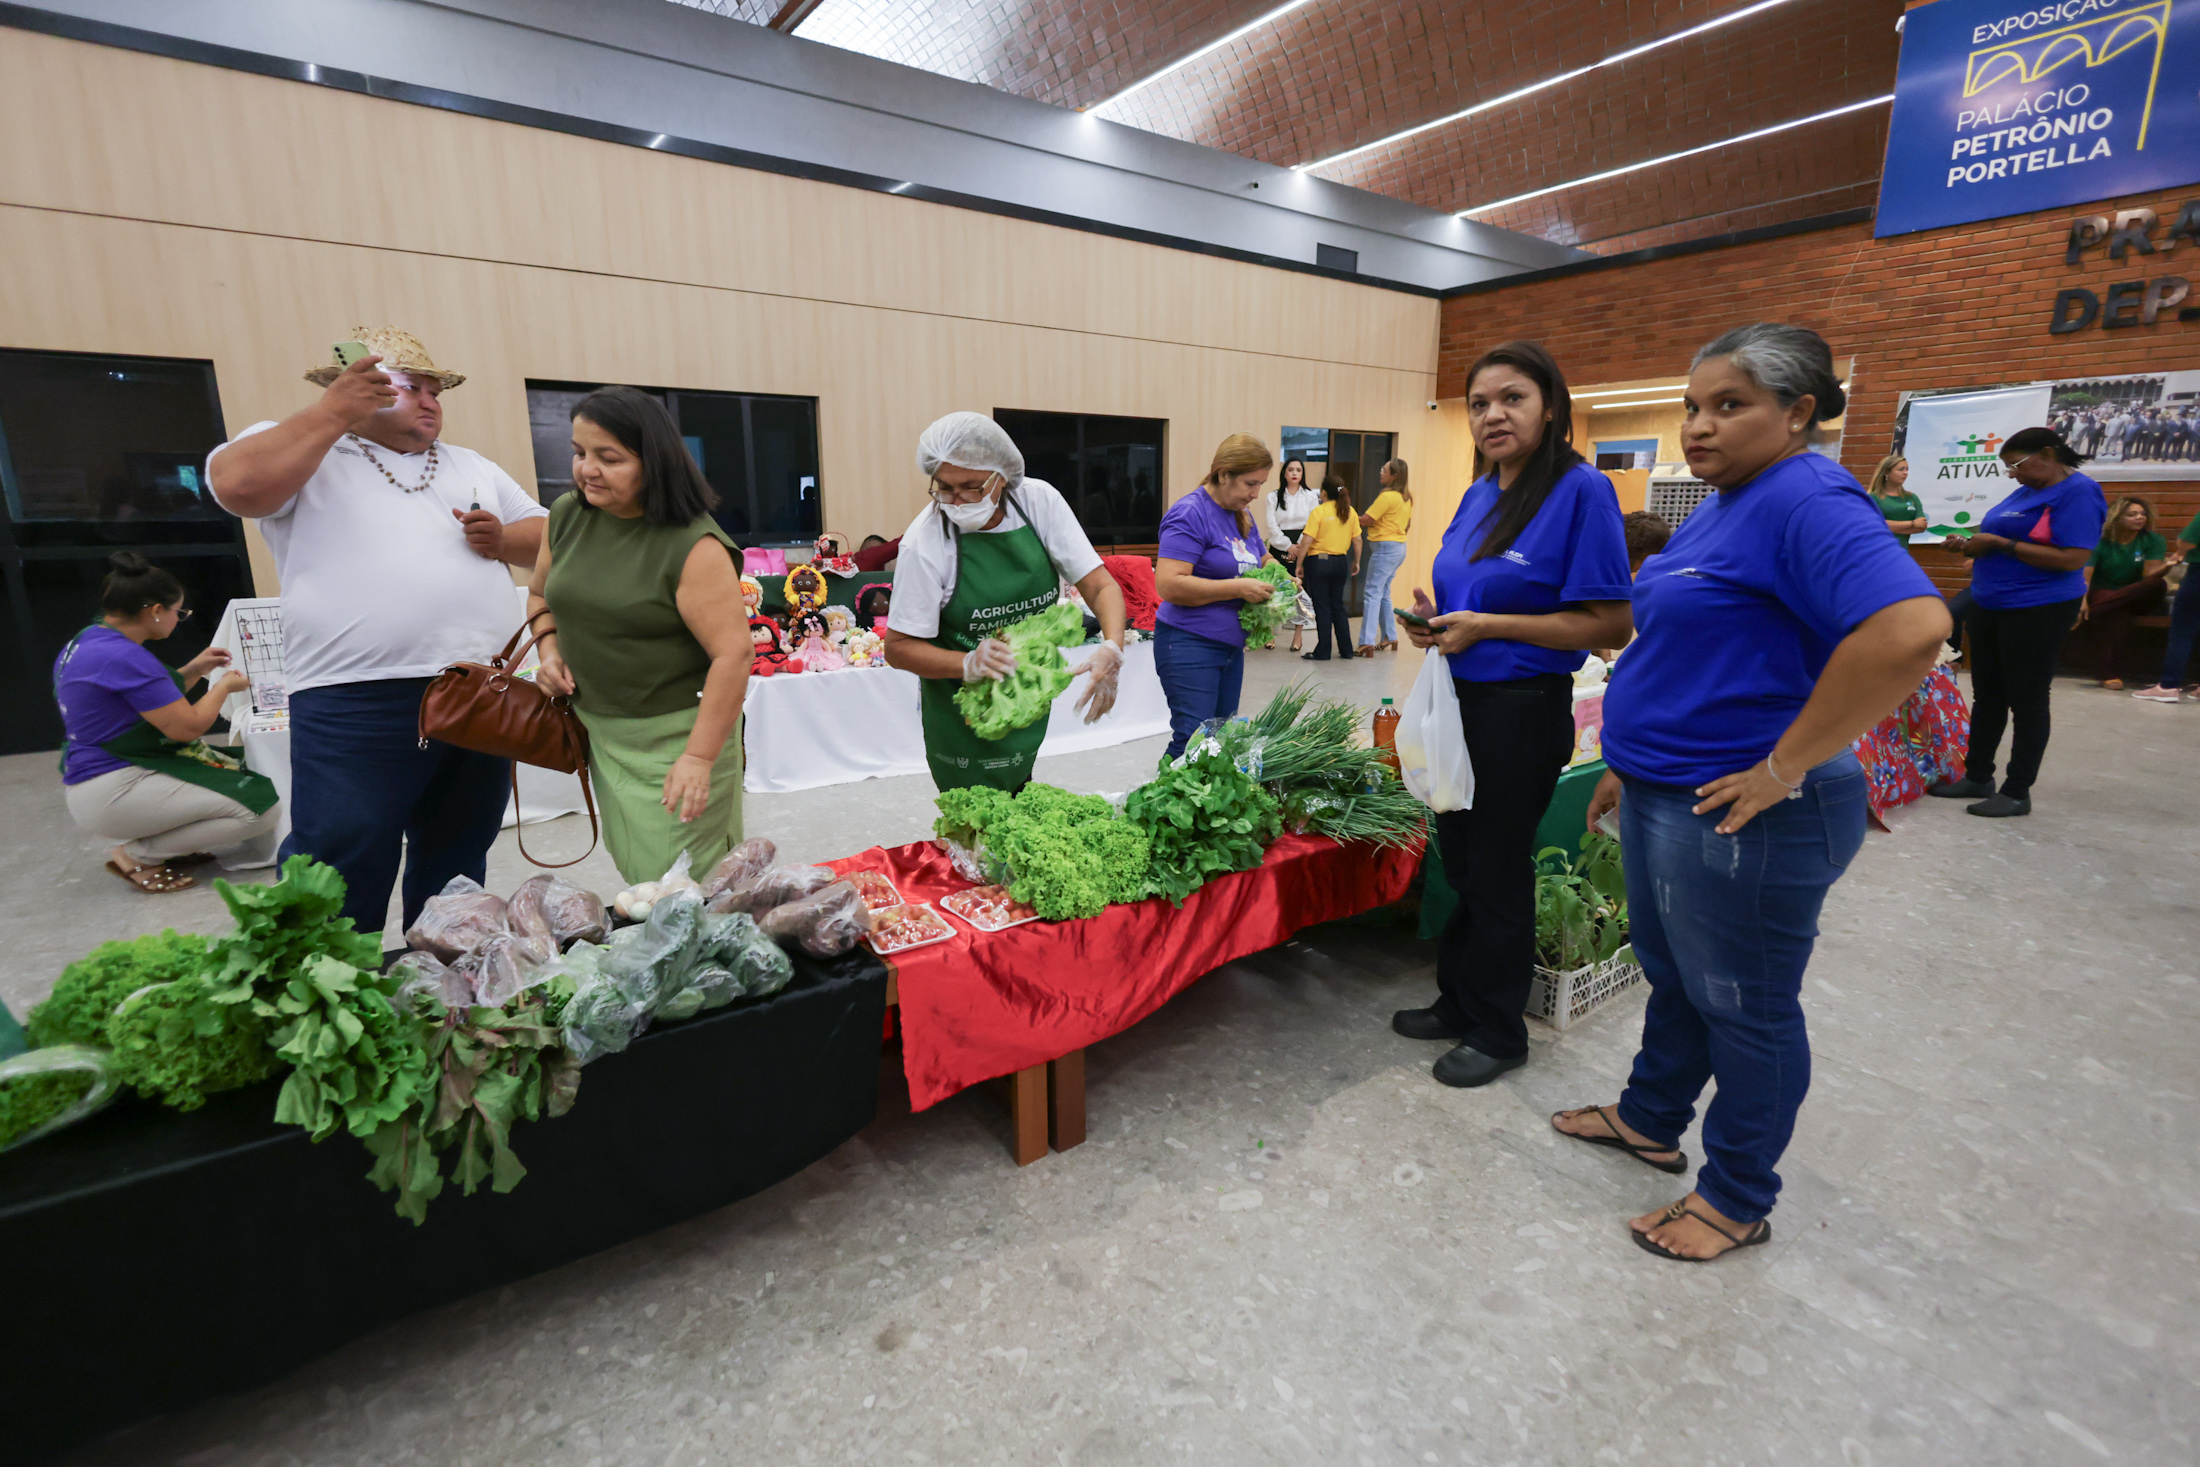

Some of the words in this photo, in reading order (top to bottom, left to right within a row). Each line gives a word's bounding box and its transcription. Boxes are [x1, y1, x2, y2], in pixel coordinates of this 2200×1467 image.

[1956, 83, 2090, 132] PALÁCIO
[1951, 107, 2113, 160] PETRÔNIO
[1946, 137, 2112, 188] PORTELLA
[1937, 463, 2000, 480] ATIVA
[970, 586, 1059, 619] AGRICULTURA
